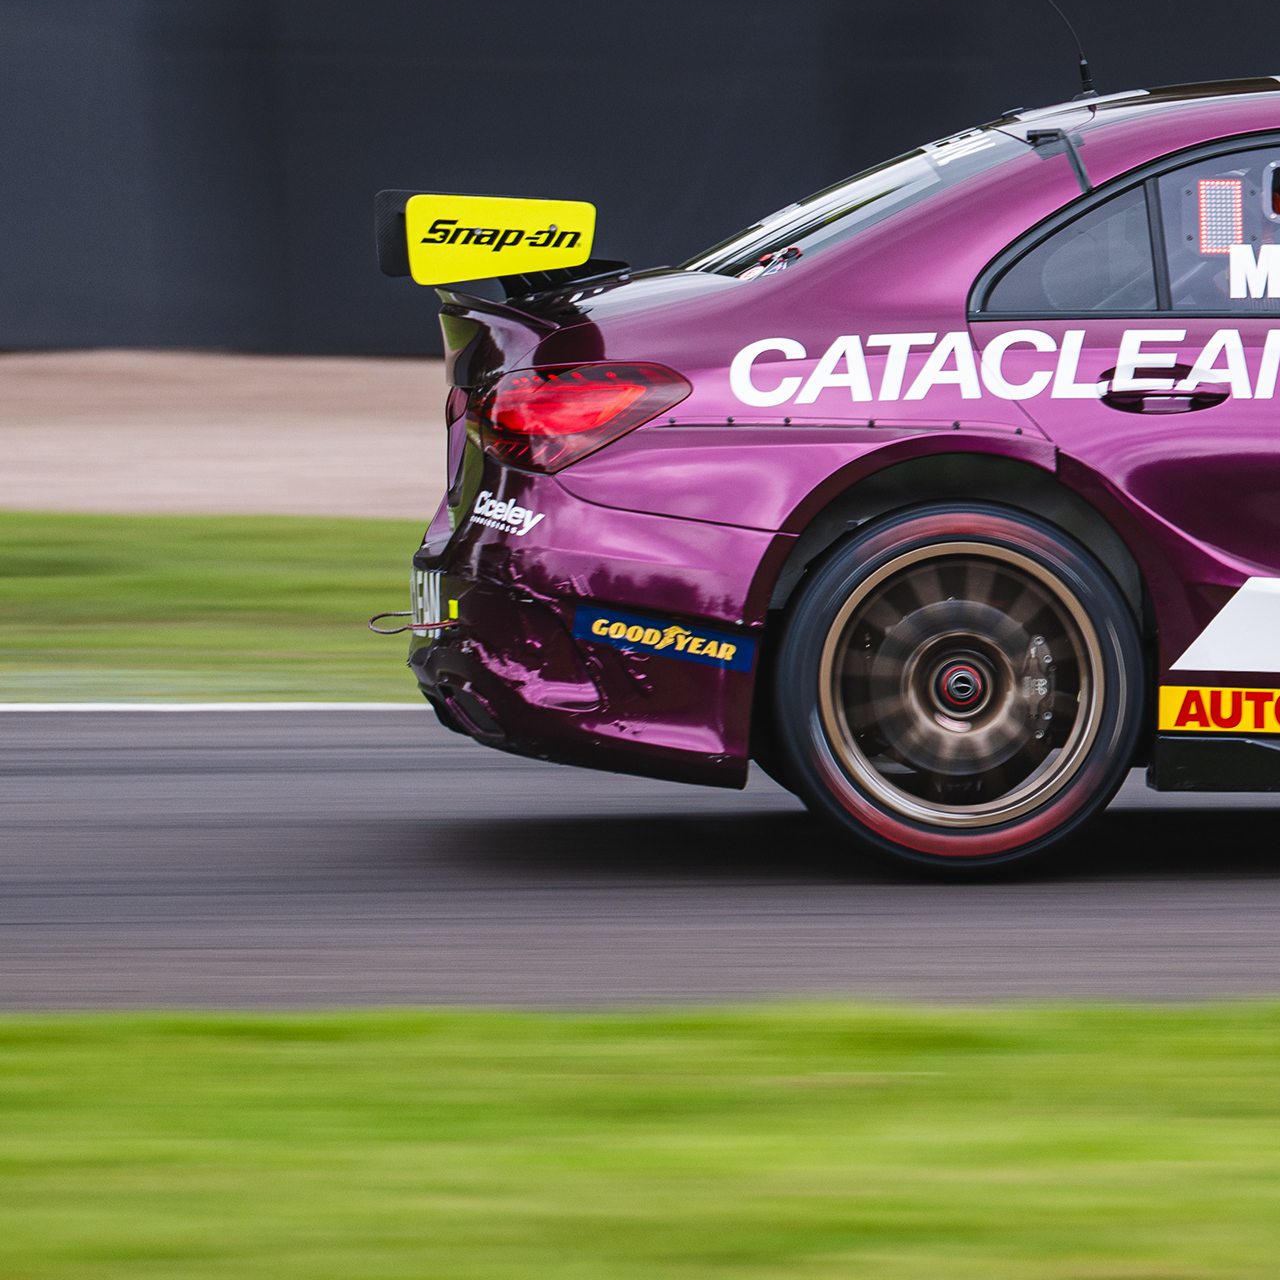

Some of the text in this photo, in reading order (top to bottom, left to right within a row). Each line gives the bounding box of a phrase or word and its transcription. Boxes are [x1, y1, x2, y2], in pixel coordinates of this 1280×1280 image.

[420, 219, 582, 252] Snap-on
[473, 490, 546, 536] Ciceley
[591, 618, 737, 661] GOODYEAR
